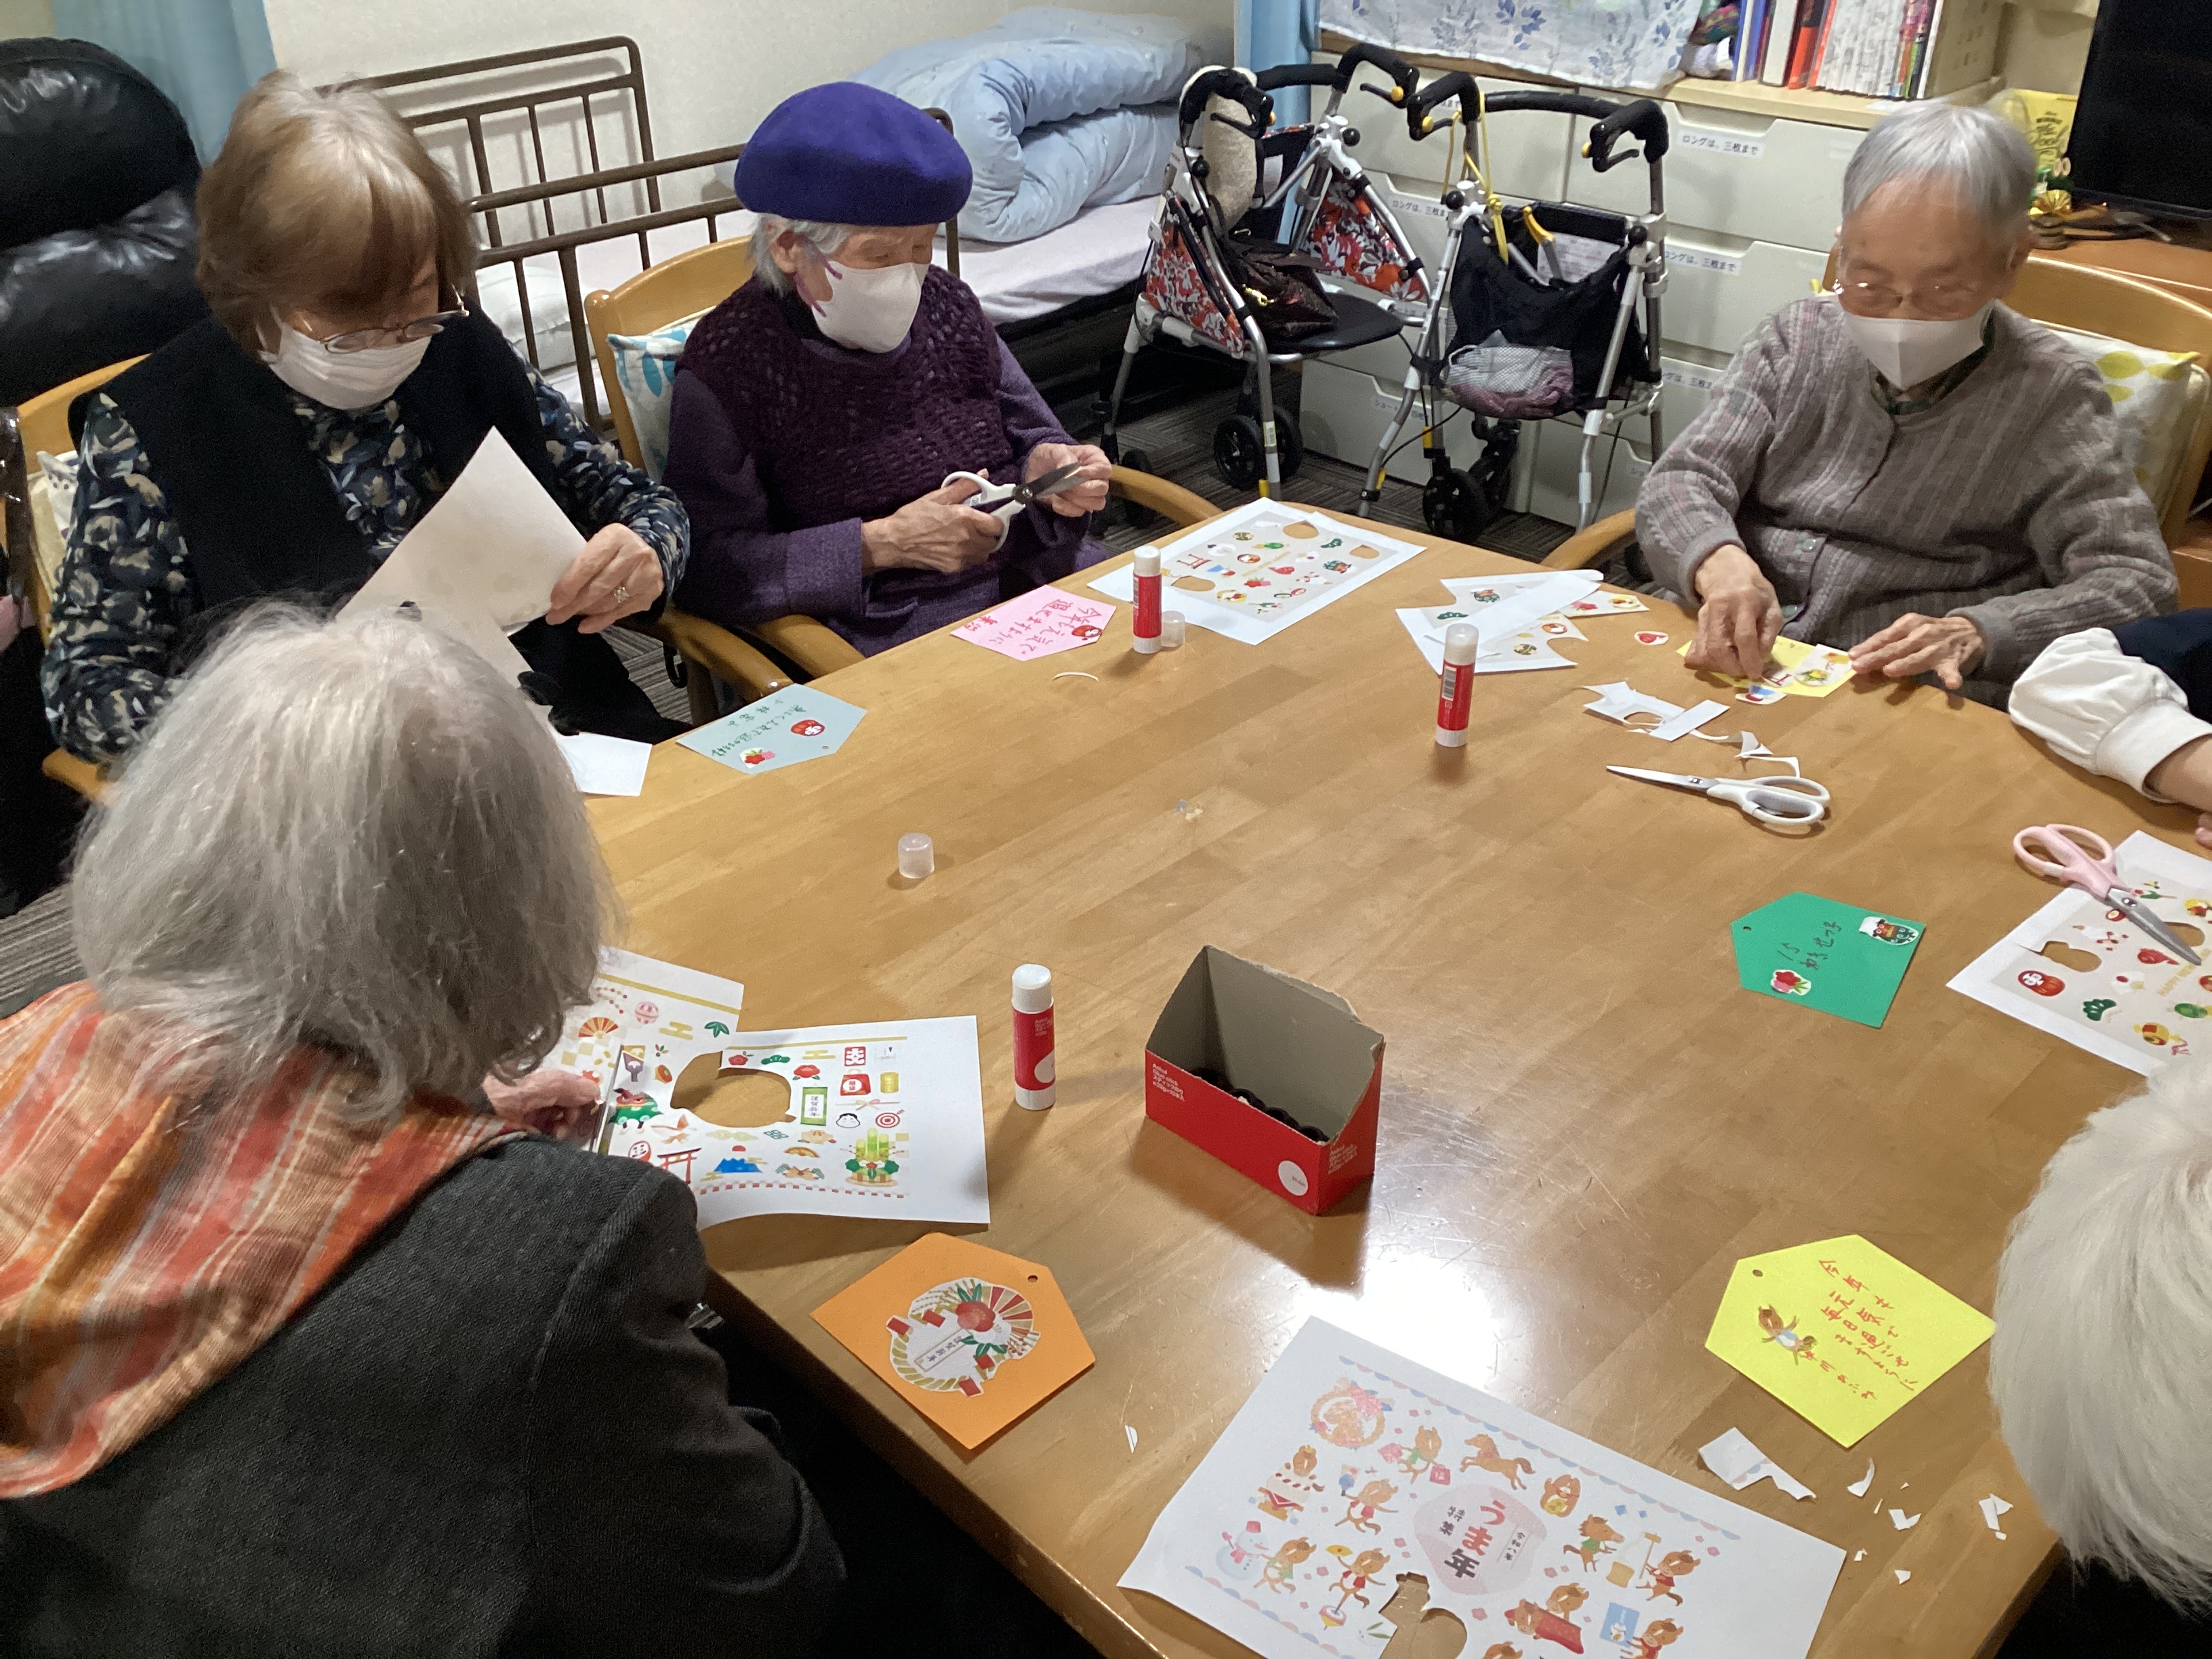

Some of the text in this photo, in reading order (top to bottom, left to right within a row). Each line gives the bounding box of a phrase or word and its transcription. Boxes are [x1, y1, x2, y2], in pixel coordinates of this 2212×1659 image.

[1392, 200, 1446, 218] ロングは、三枚ま
[1818, 1259, 1895, 1310] 今年も
[1828, 1290, 1900, 1338] 元気で
[1443, 1499, 1507, 1578] うま年
